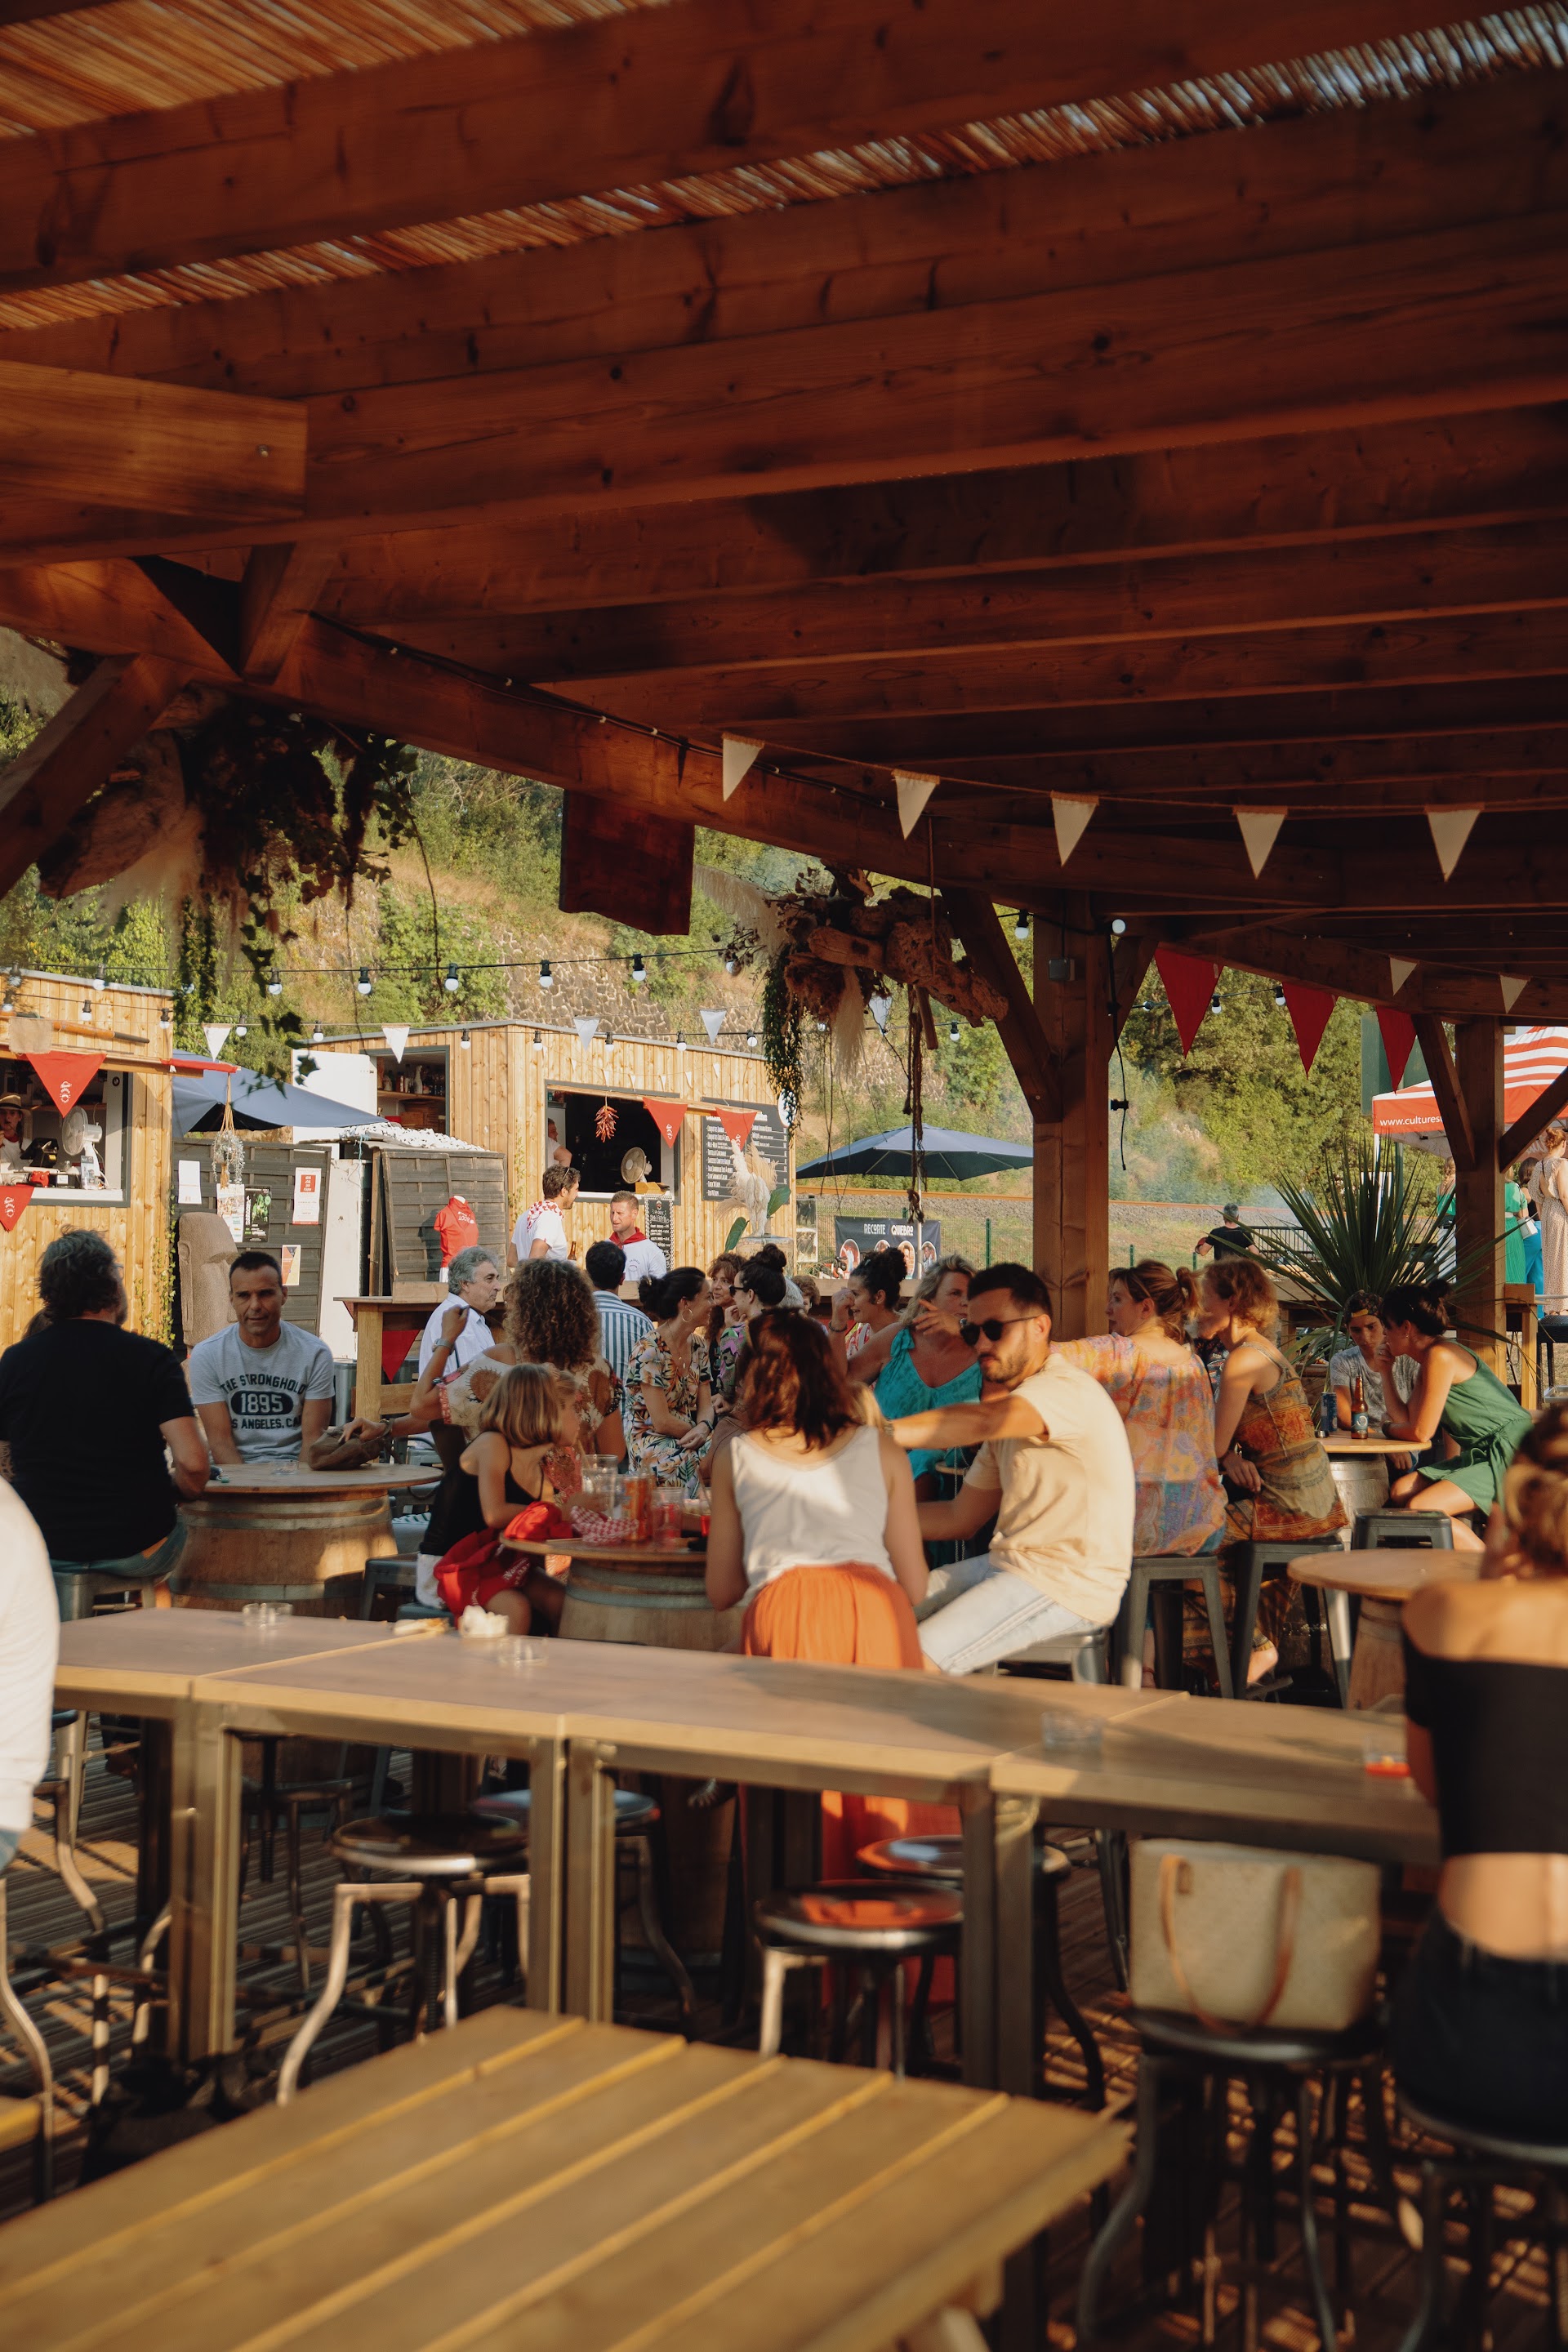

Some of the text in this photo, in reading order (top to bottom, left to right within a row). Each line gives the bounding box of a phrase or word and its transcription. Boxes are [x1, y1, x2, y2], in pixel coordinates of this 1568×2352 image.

[863, 1223, 886, 1235] RECORTE
[891, 1224, 914, 1236] QUIEBRO
[220, 1373, 306, 1395] THE STRONGHOLD
[240, 1392, 283, 1413] 1895
[241, 1418, 285, 1430] ANGELES,
